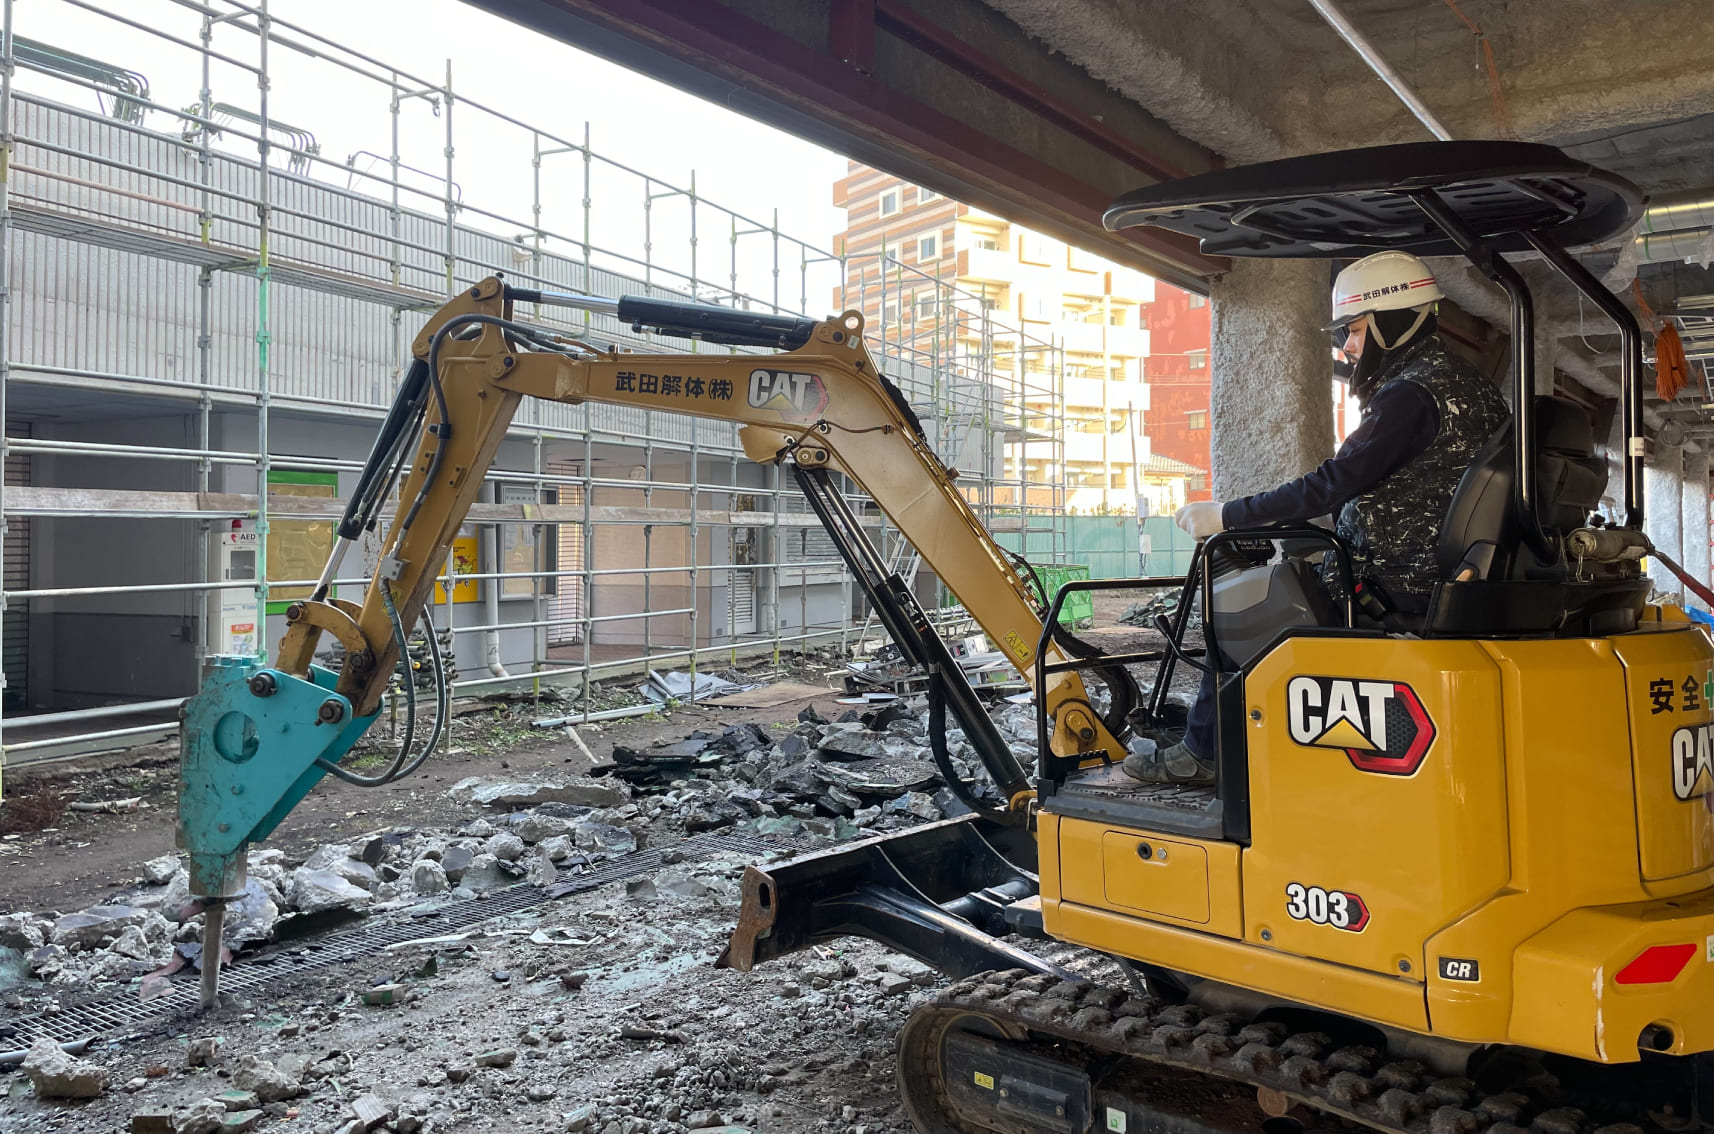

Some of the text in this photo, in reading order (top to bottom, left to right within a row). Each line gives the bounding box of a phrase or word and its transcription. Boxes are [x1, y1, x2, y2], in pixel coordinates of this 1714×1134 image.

[751, 371, 812, 411] CAT
[240, 533, 256, 541] AED
[1288, 676, 1394, 751] CAT
[1649, 675, 1700, 714] 安全
[1673, 724, 1714, 798] CA
[1287, 883, 1349, 928] 303
[1446, 961, 1472, 978] CR
